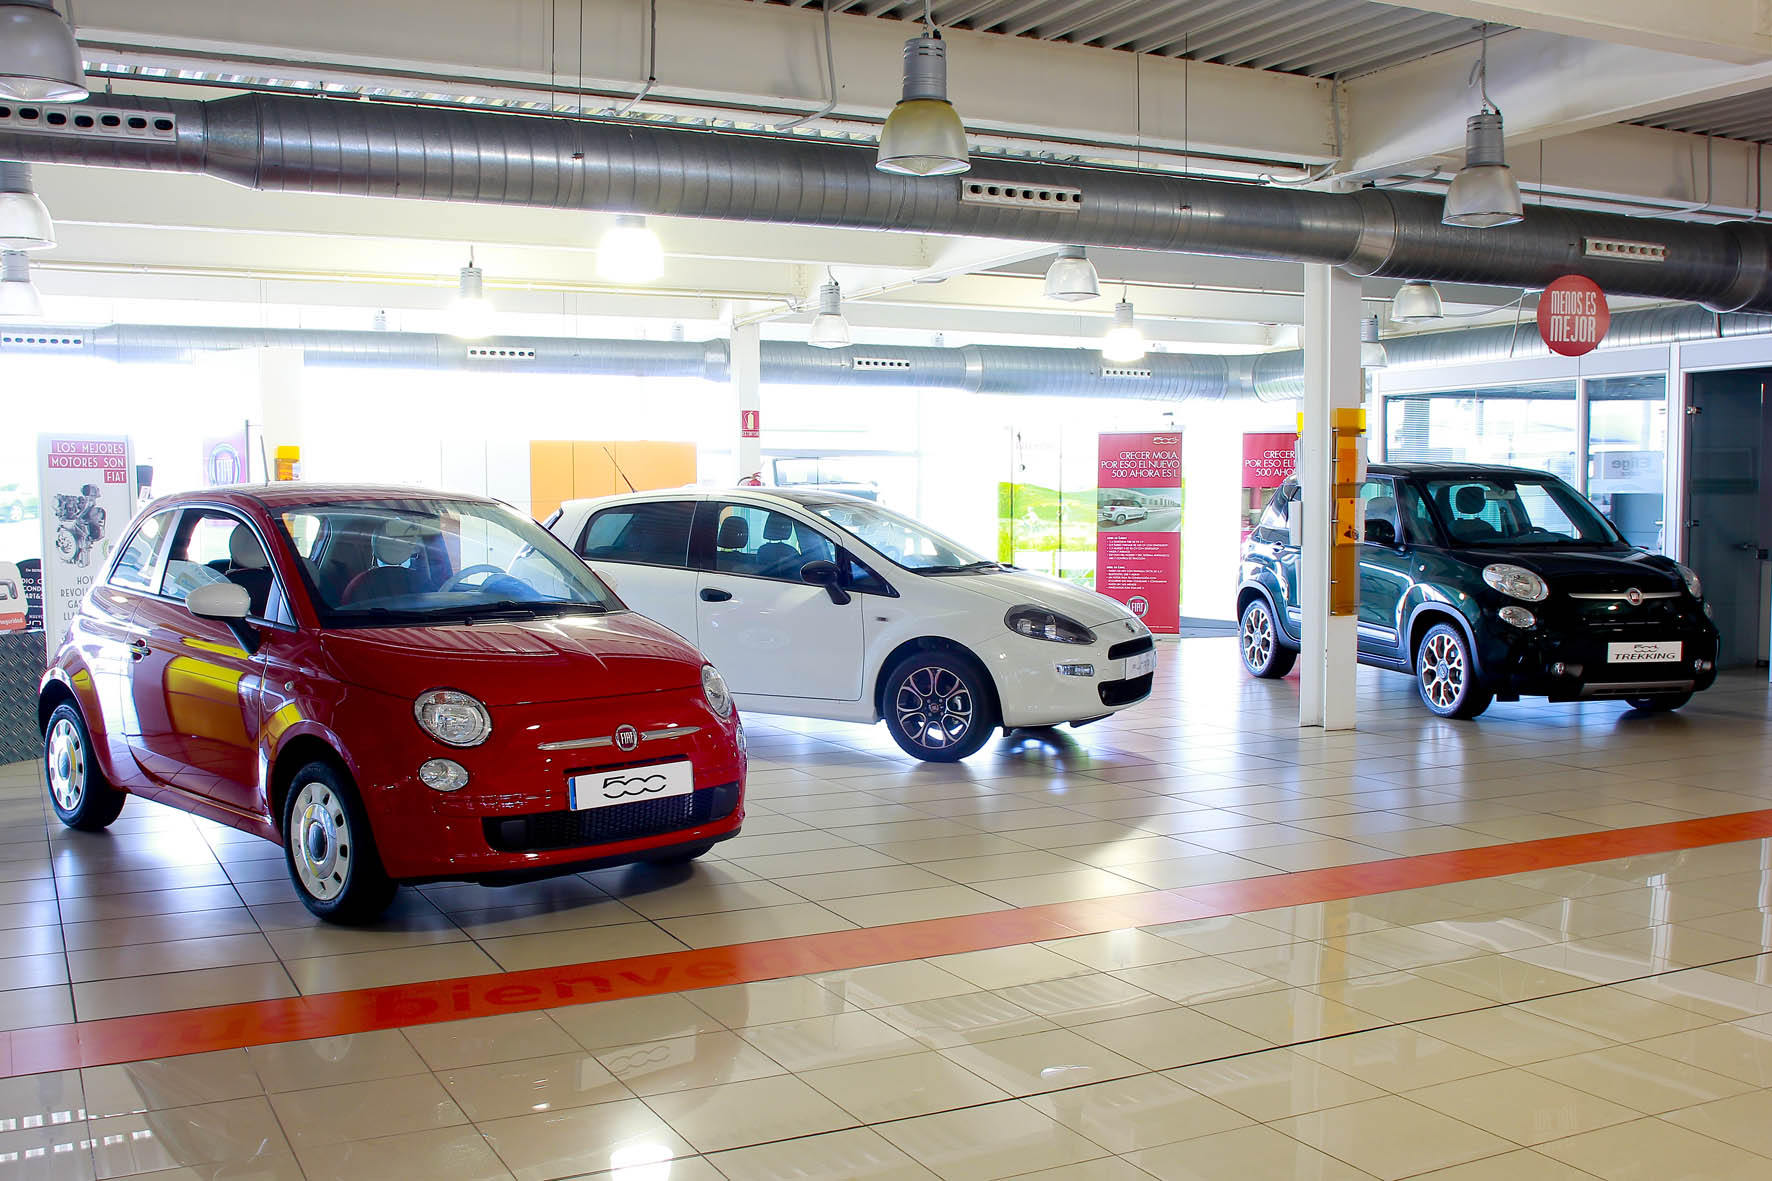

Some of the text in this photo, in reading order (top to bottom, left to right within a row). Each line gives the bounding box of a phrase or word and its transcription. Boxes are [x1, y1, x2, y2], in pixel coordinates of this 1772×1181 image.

[1551, 290, 1597, 315] MENOS ES
[1549, 315, 1596, 343] MEJOR
[56, 442, 124, 454] LOS MEJORES
[1120, 451, 1151, 460] CRECER
[1263, 450, 1295, 459] CRECER
[51, 456, 124, 468] MOTORES SON
[1101, 459, 1180, 469] POR ESO EL NUEVO
[1245, 459, 1291, 468] POR ESO EL
[106, 471, 125, 482] FIAT
[1112, 469, 1128, 478] 500
[1129, 469, 1160, 478] AHORA
[1162, 469, 1172, 478] ES
[1255, 468, 1296, 477] 500 AHO
[77, 575, 94, 585] HOY
[1131, 602, 1145, 613] FIAT
[620, 732, 634, 745] FIAT
[602, 774, 667, 799] 500
